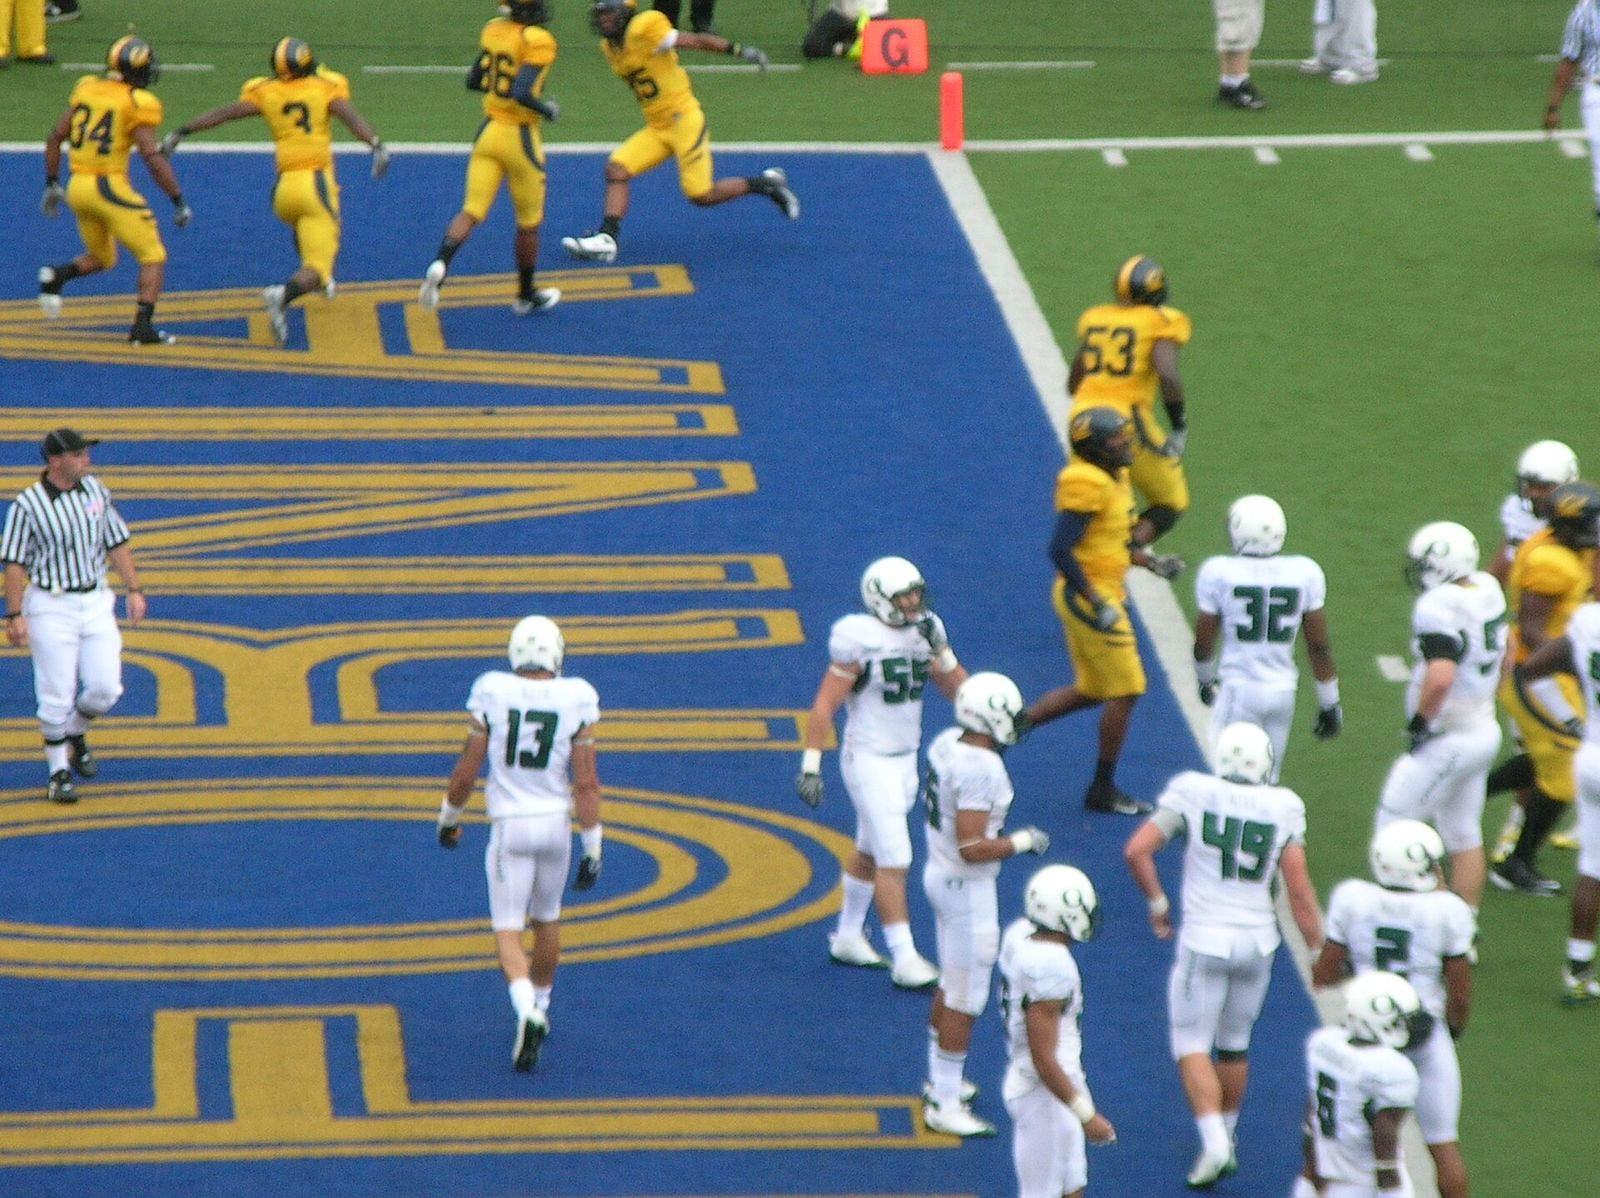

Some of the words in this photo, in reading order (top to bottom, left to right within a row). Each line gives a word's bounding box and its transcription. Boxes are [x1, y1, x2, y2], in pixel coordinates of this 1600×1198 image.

[881, 28, 909, 68] G
[281, 102, 313, 134] 3
[1233, 586, 1300, 642] 32
[506, 708, 559, 770] 13
[1203, 810, 1277, 880] 49
[1374, 926, 1411, 979] 2
